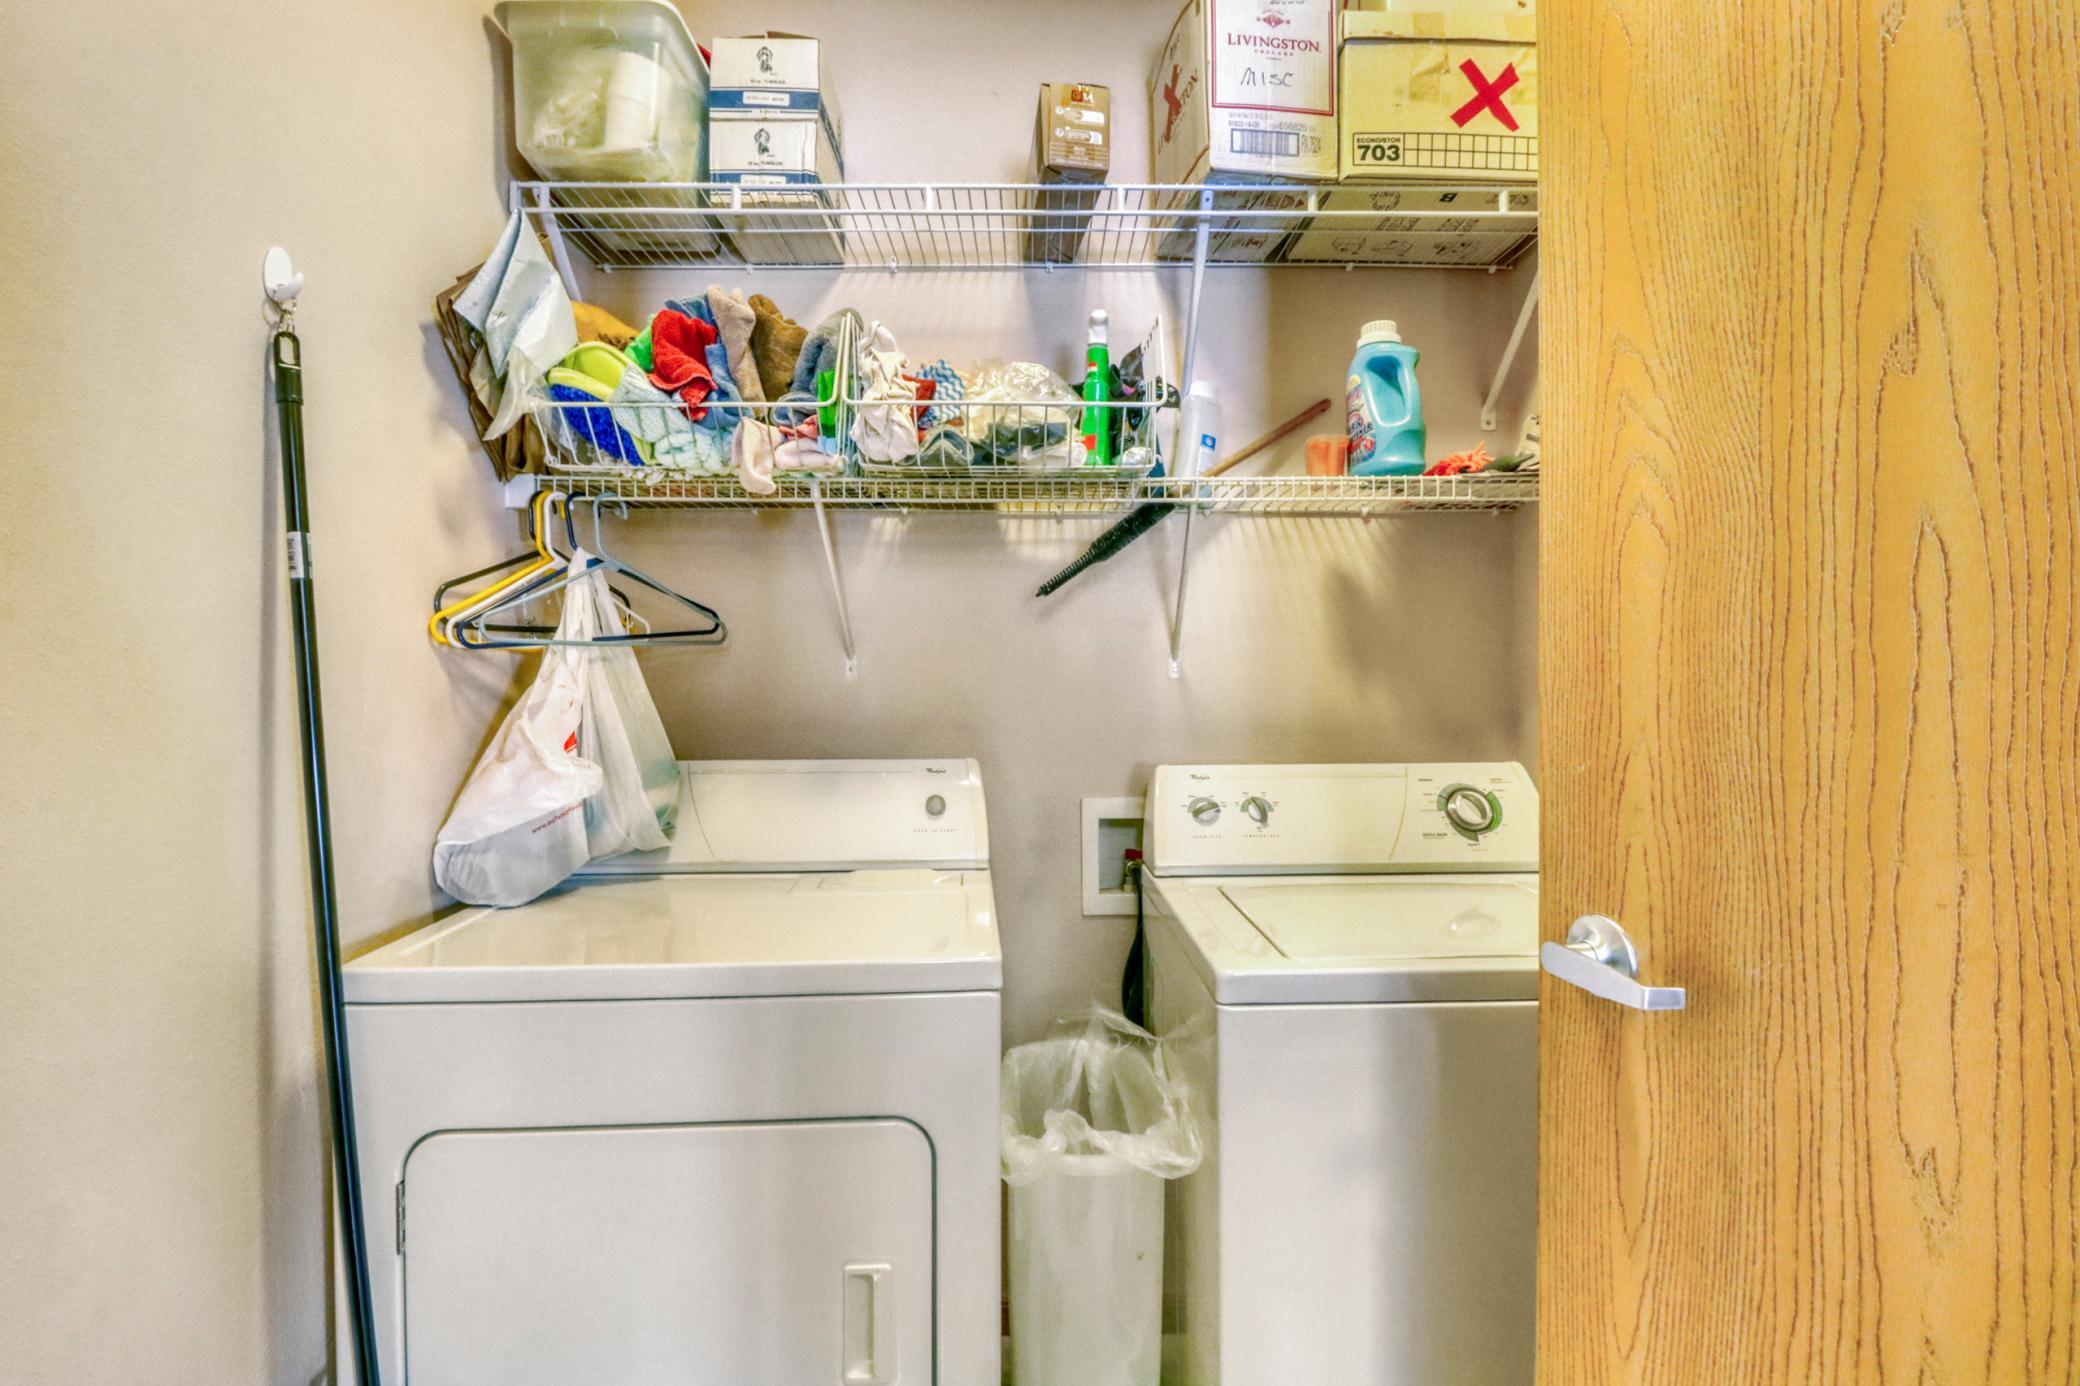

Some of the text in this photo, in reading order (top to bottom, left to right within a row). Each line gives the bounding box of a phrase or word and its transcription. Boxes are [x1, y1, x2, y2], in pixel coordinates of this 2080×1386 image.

[1227, 33, 1320, 53] LIVINGSTON
[1240, 66, 1294, 87] MISC
[1357, 144, 1401, 162] 703
